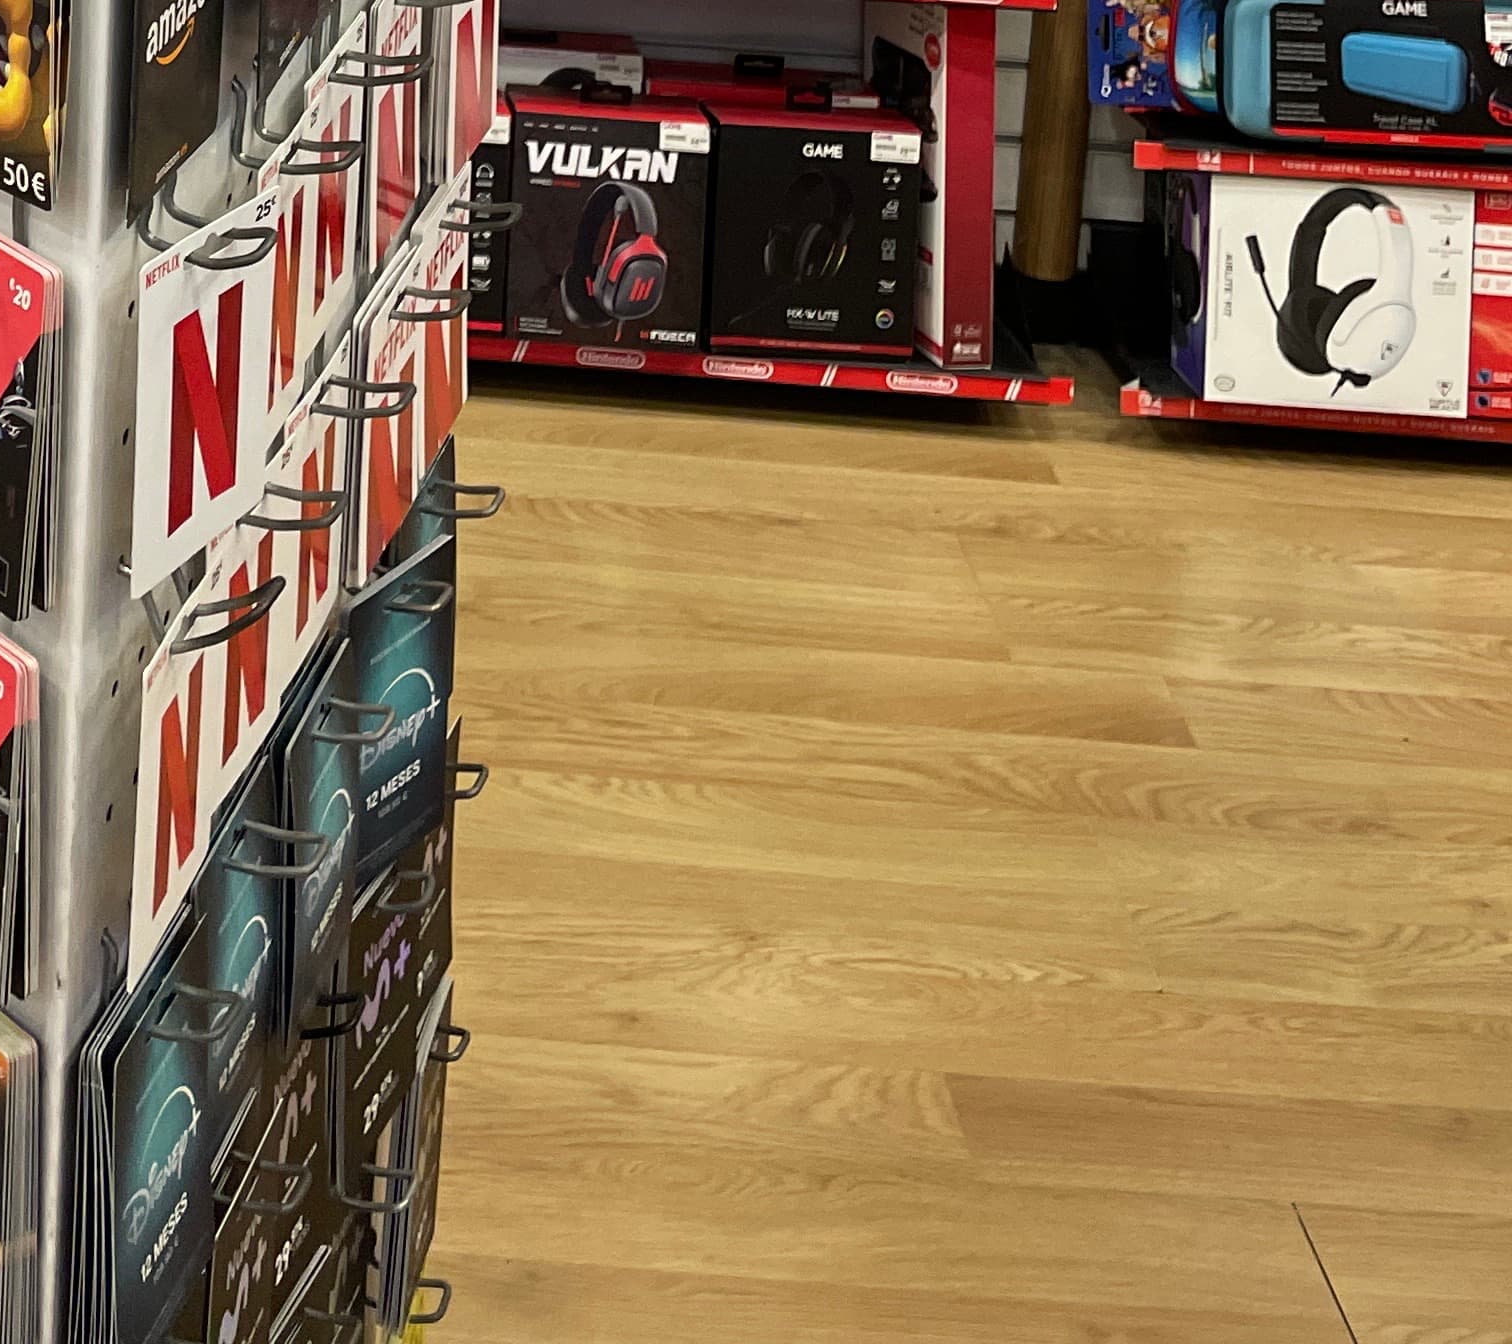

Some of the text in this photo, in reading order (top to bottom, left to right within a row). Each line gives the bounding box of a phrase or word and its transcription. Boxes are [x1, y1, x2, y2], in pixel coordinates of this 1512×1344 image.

[1383, 0, 1428, 17] GAME
[525, 139, 679, 185] VULKAN
[803, 142, 843, 160] GAME
[145, 254, 181, 290] NETFLIX
[378, 758, 421, 805] MESES
